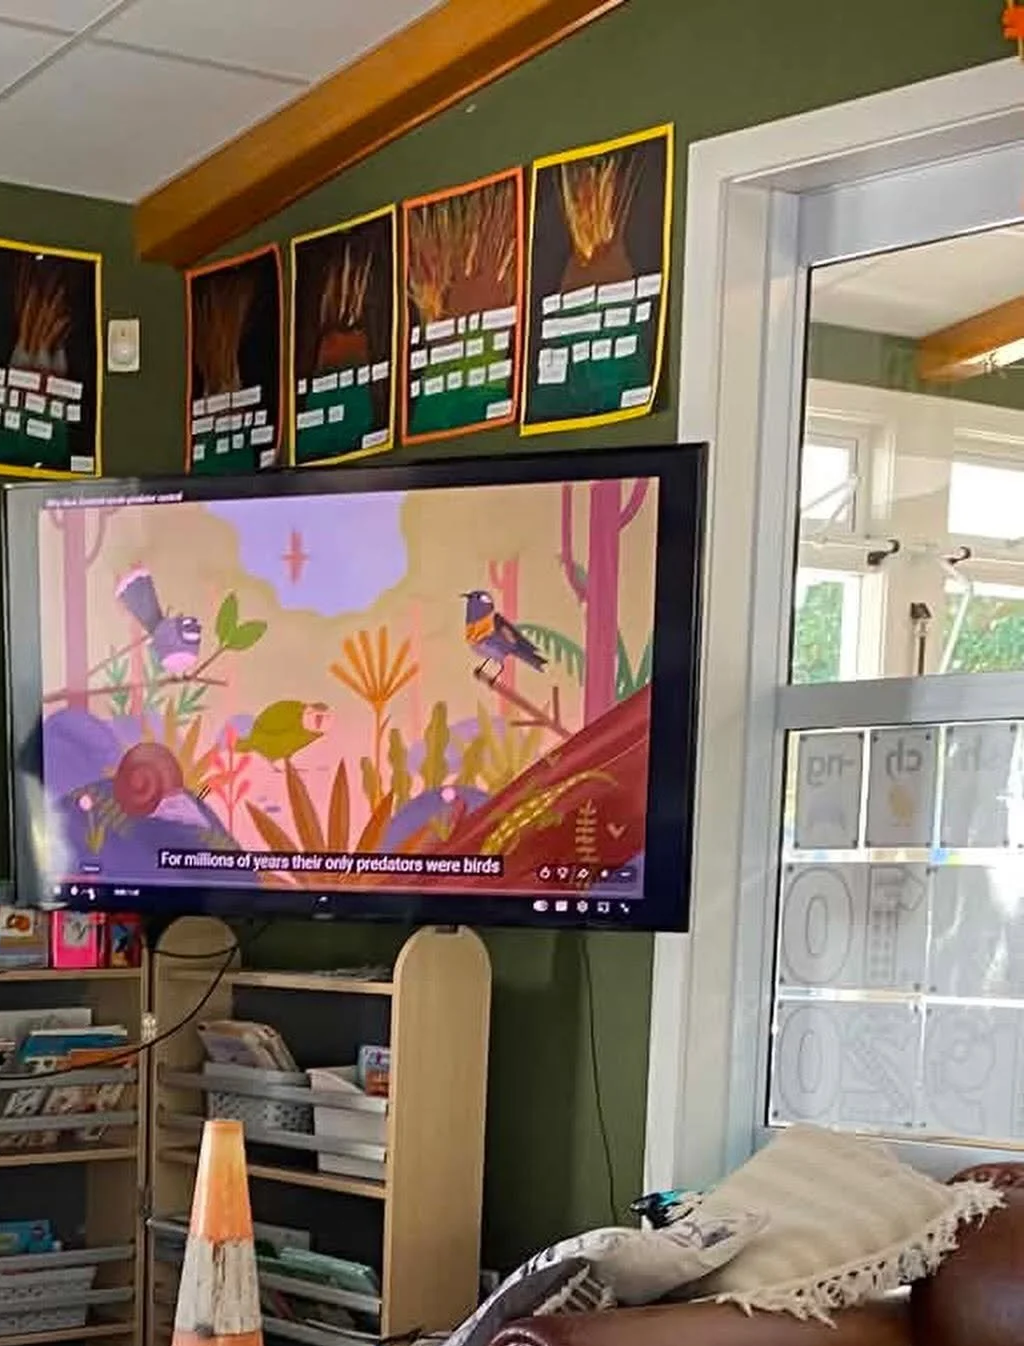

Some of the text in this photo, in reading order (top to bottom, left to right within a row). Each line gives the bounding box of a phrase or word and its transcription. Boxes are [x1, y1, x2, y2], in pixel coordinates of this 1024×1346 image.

[161, 852, 501, 875] For millions of years their only predators were birds
